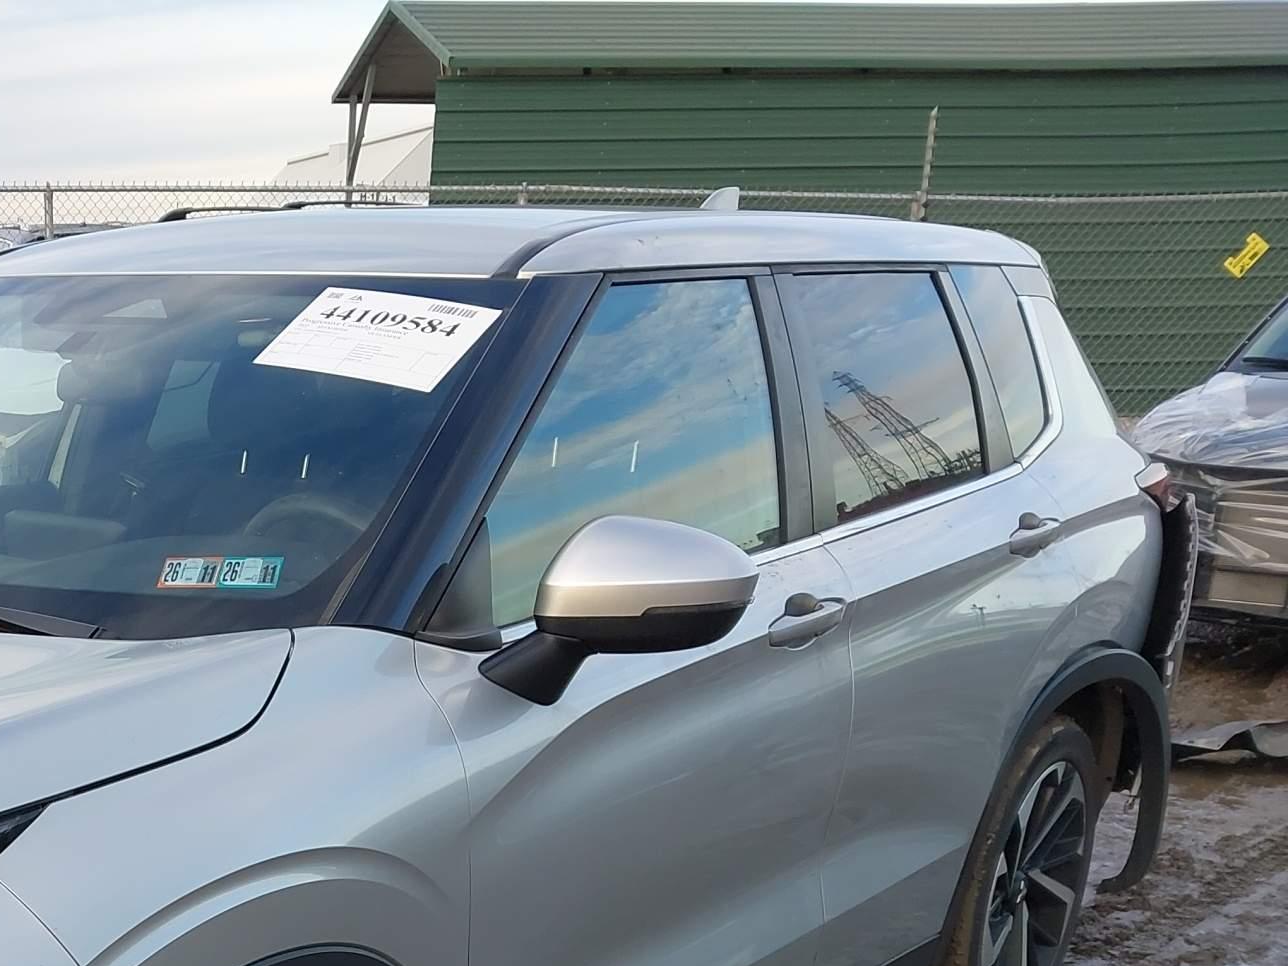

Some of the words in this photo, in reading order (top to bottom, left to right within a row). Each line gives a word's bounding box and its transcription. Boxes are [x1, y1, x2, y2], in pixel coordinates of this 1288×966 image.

[320, 304, 462, 338] 44109584
[163, 561, 182, 583] 26
[201, 564, 218, 584] 11
[222, 560, 241, 583] 26
[261, 564, 279, 584] 11
